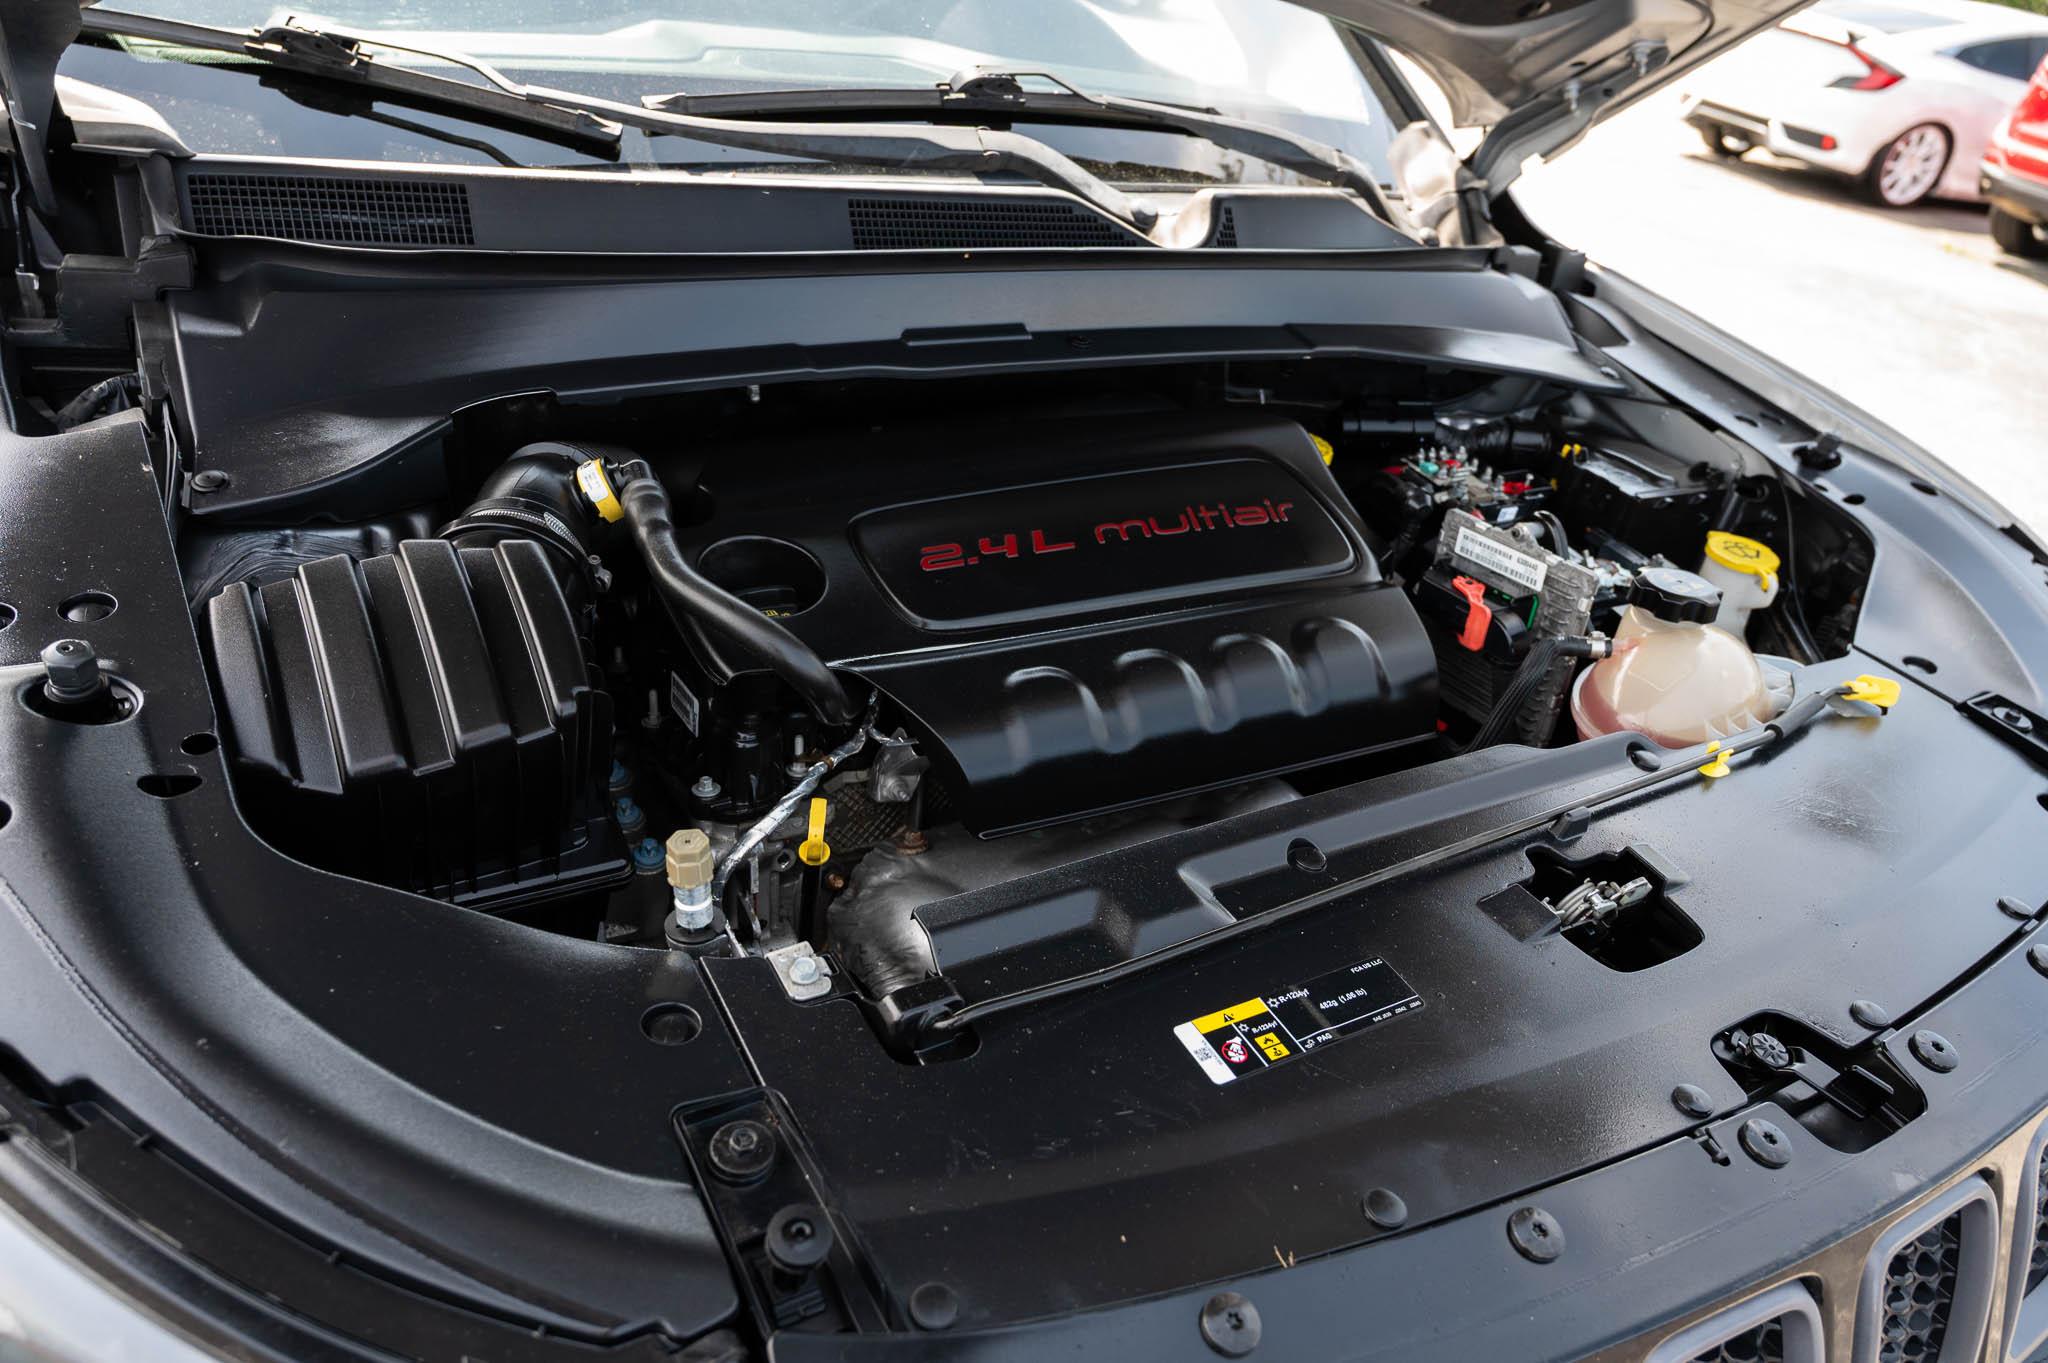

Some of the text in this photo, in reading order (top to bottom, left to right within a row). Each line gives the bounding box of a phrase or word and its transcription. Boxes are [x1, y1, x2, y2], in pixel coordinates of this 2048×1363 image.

[1094, 497, 1294, 545] multiair
[1350, 966, 1363, 975] FCA
[1370, 958, 1383, 967] LLC
[1355, 988, 1368, 997] lb)
[1316, 1032, 1333, 1043] PAG
